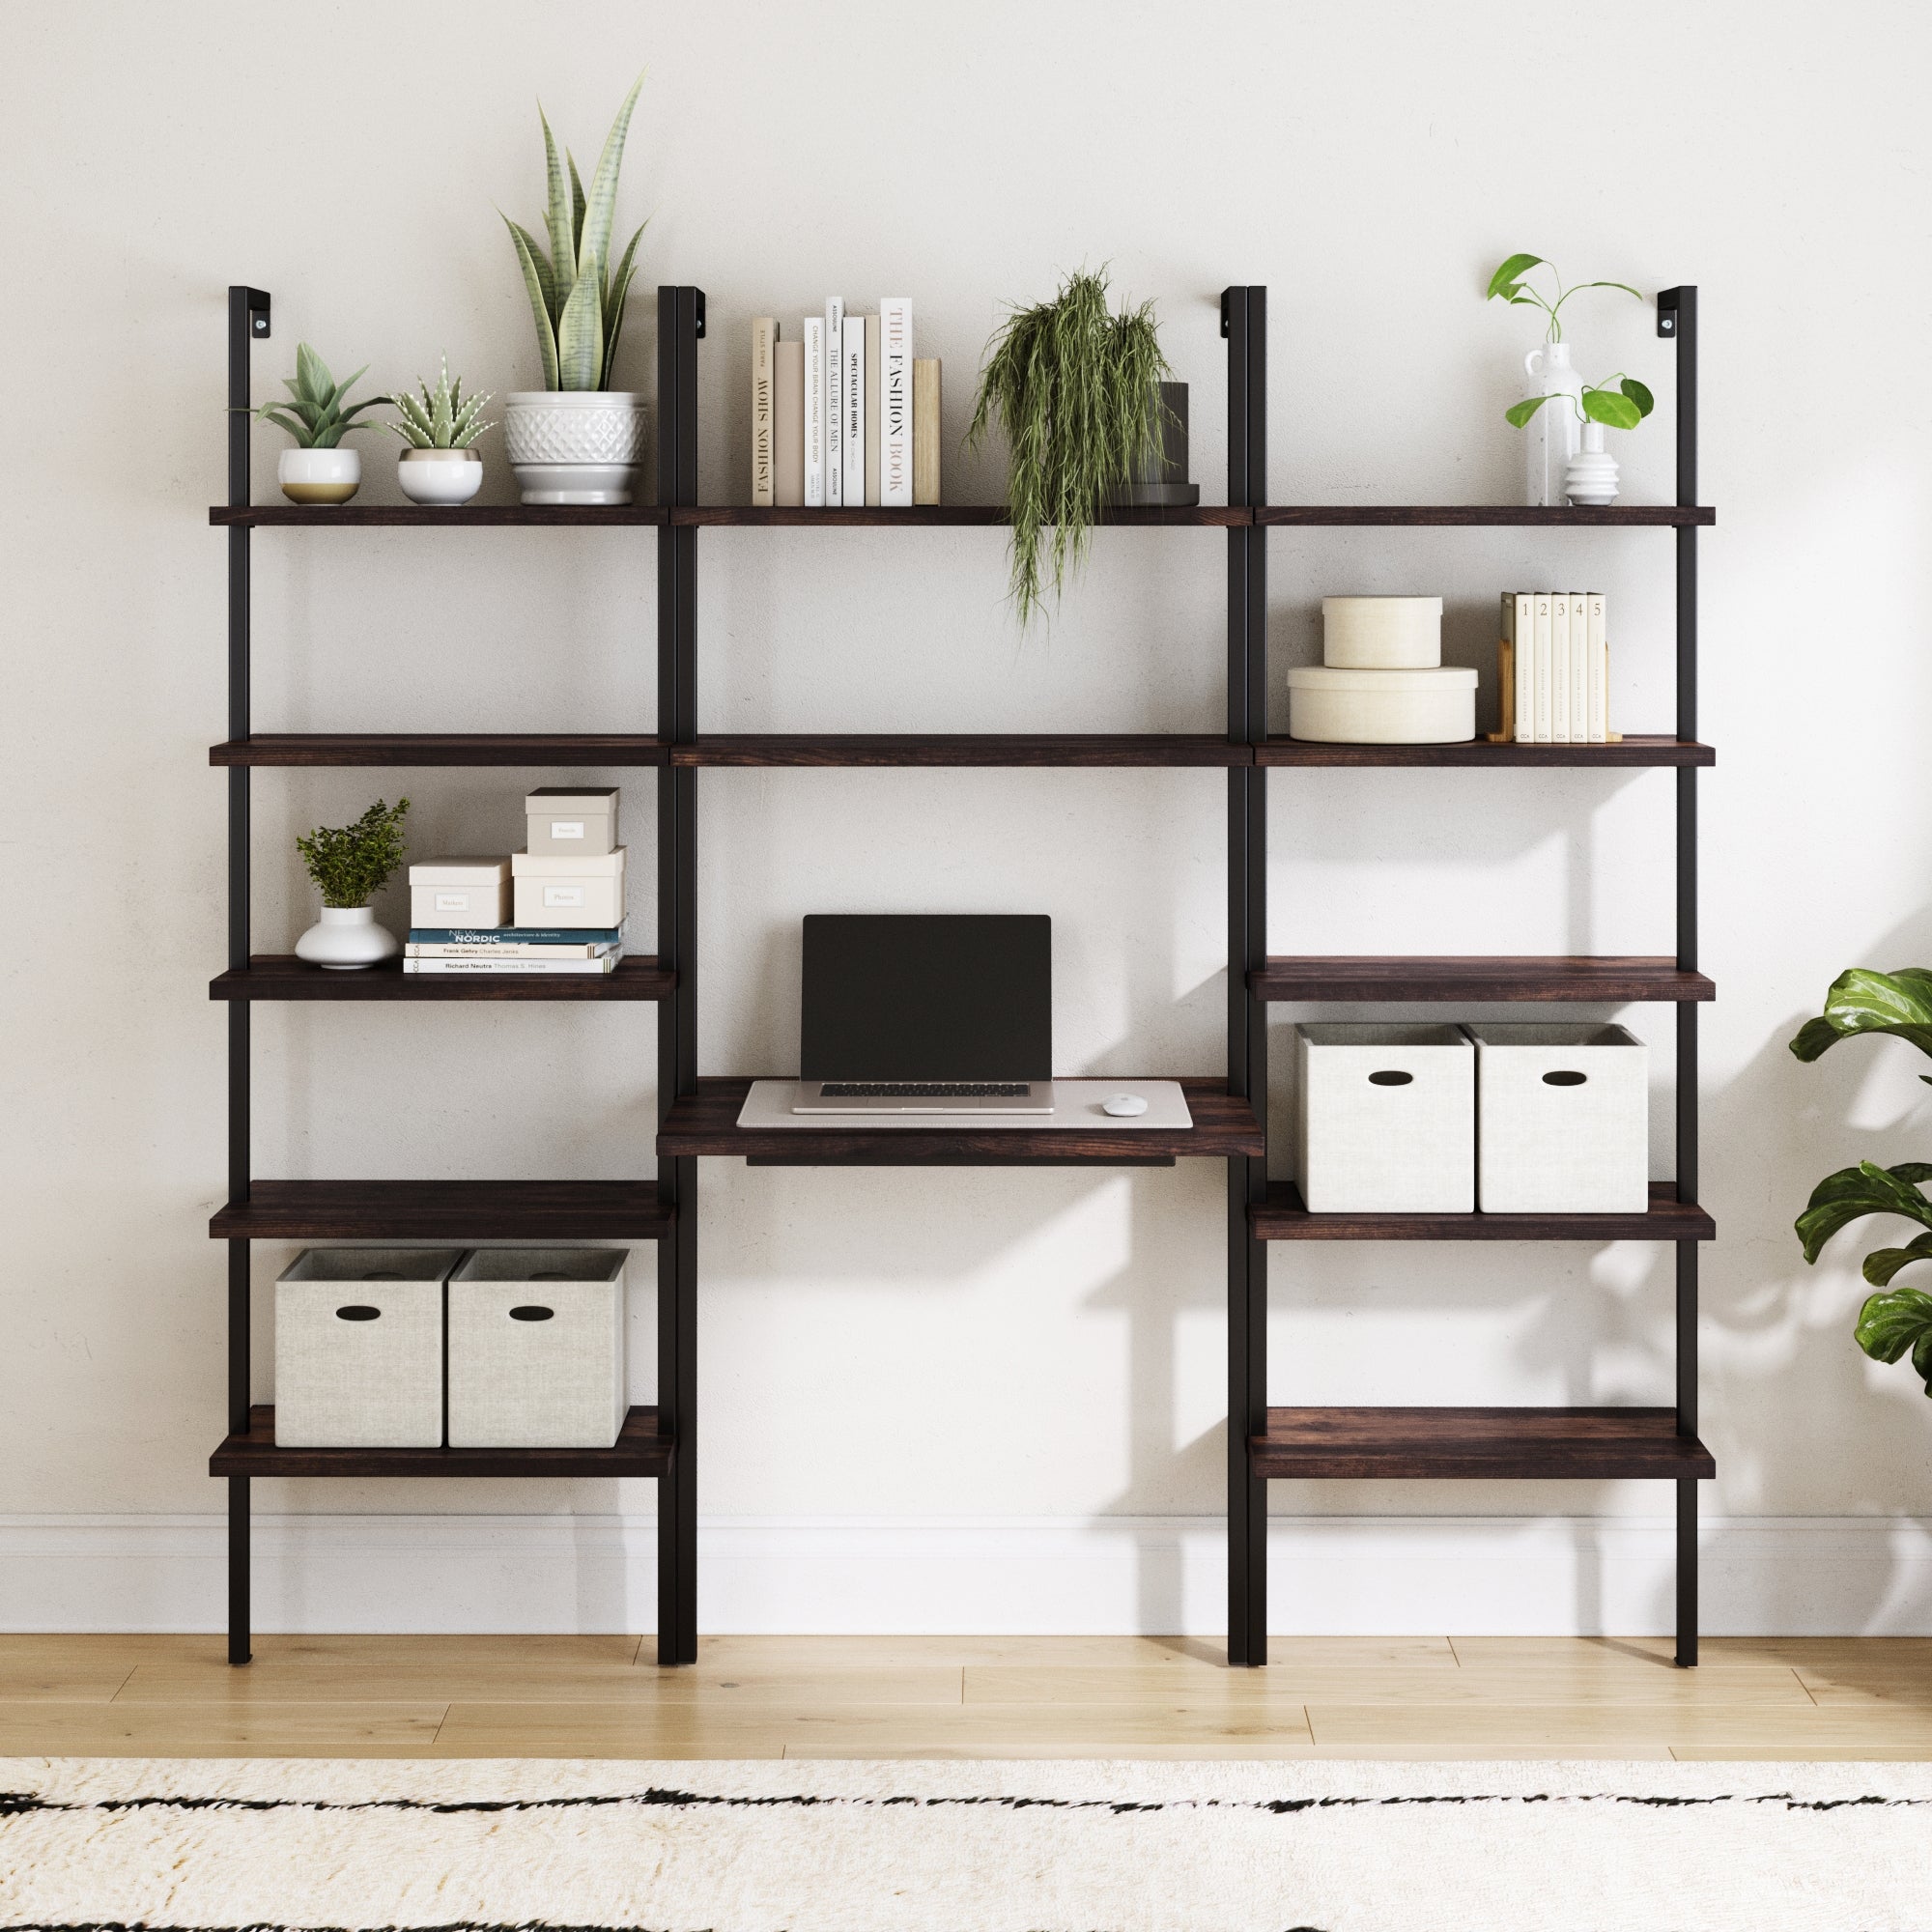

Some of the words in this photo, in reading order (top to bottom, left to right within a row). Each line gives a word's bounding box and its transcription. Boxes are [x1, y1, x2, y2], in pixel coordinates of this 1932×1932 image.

[889, 308, 903, 348] THE
[830, 348, 838, 368] THE
[758, 377, 768, 422] SHOW
[830, 371, 838, 410] ALLURE
[889, 355, 903, 436] FASHION
[830, 413, 838, 426] OF
[830, 429, 838, 452] MEN
[758, 428, 768, 492] FASHION
[889, 443, 903, 492] BOOK
[1523, 603, 1528, 616] 1
[1540, 603, 1547, 616] 2
[1558, 603, 1565, 616] 3
[1576, 603, 1583, 616] 4
[1594, 603, 1601, 616] 5
